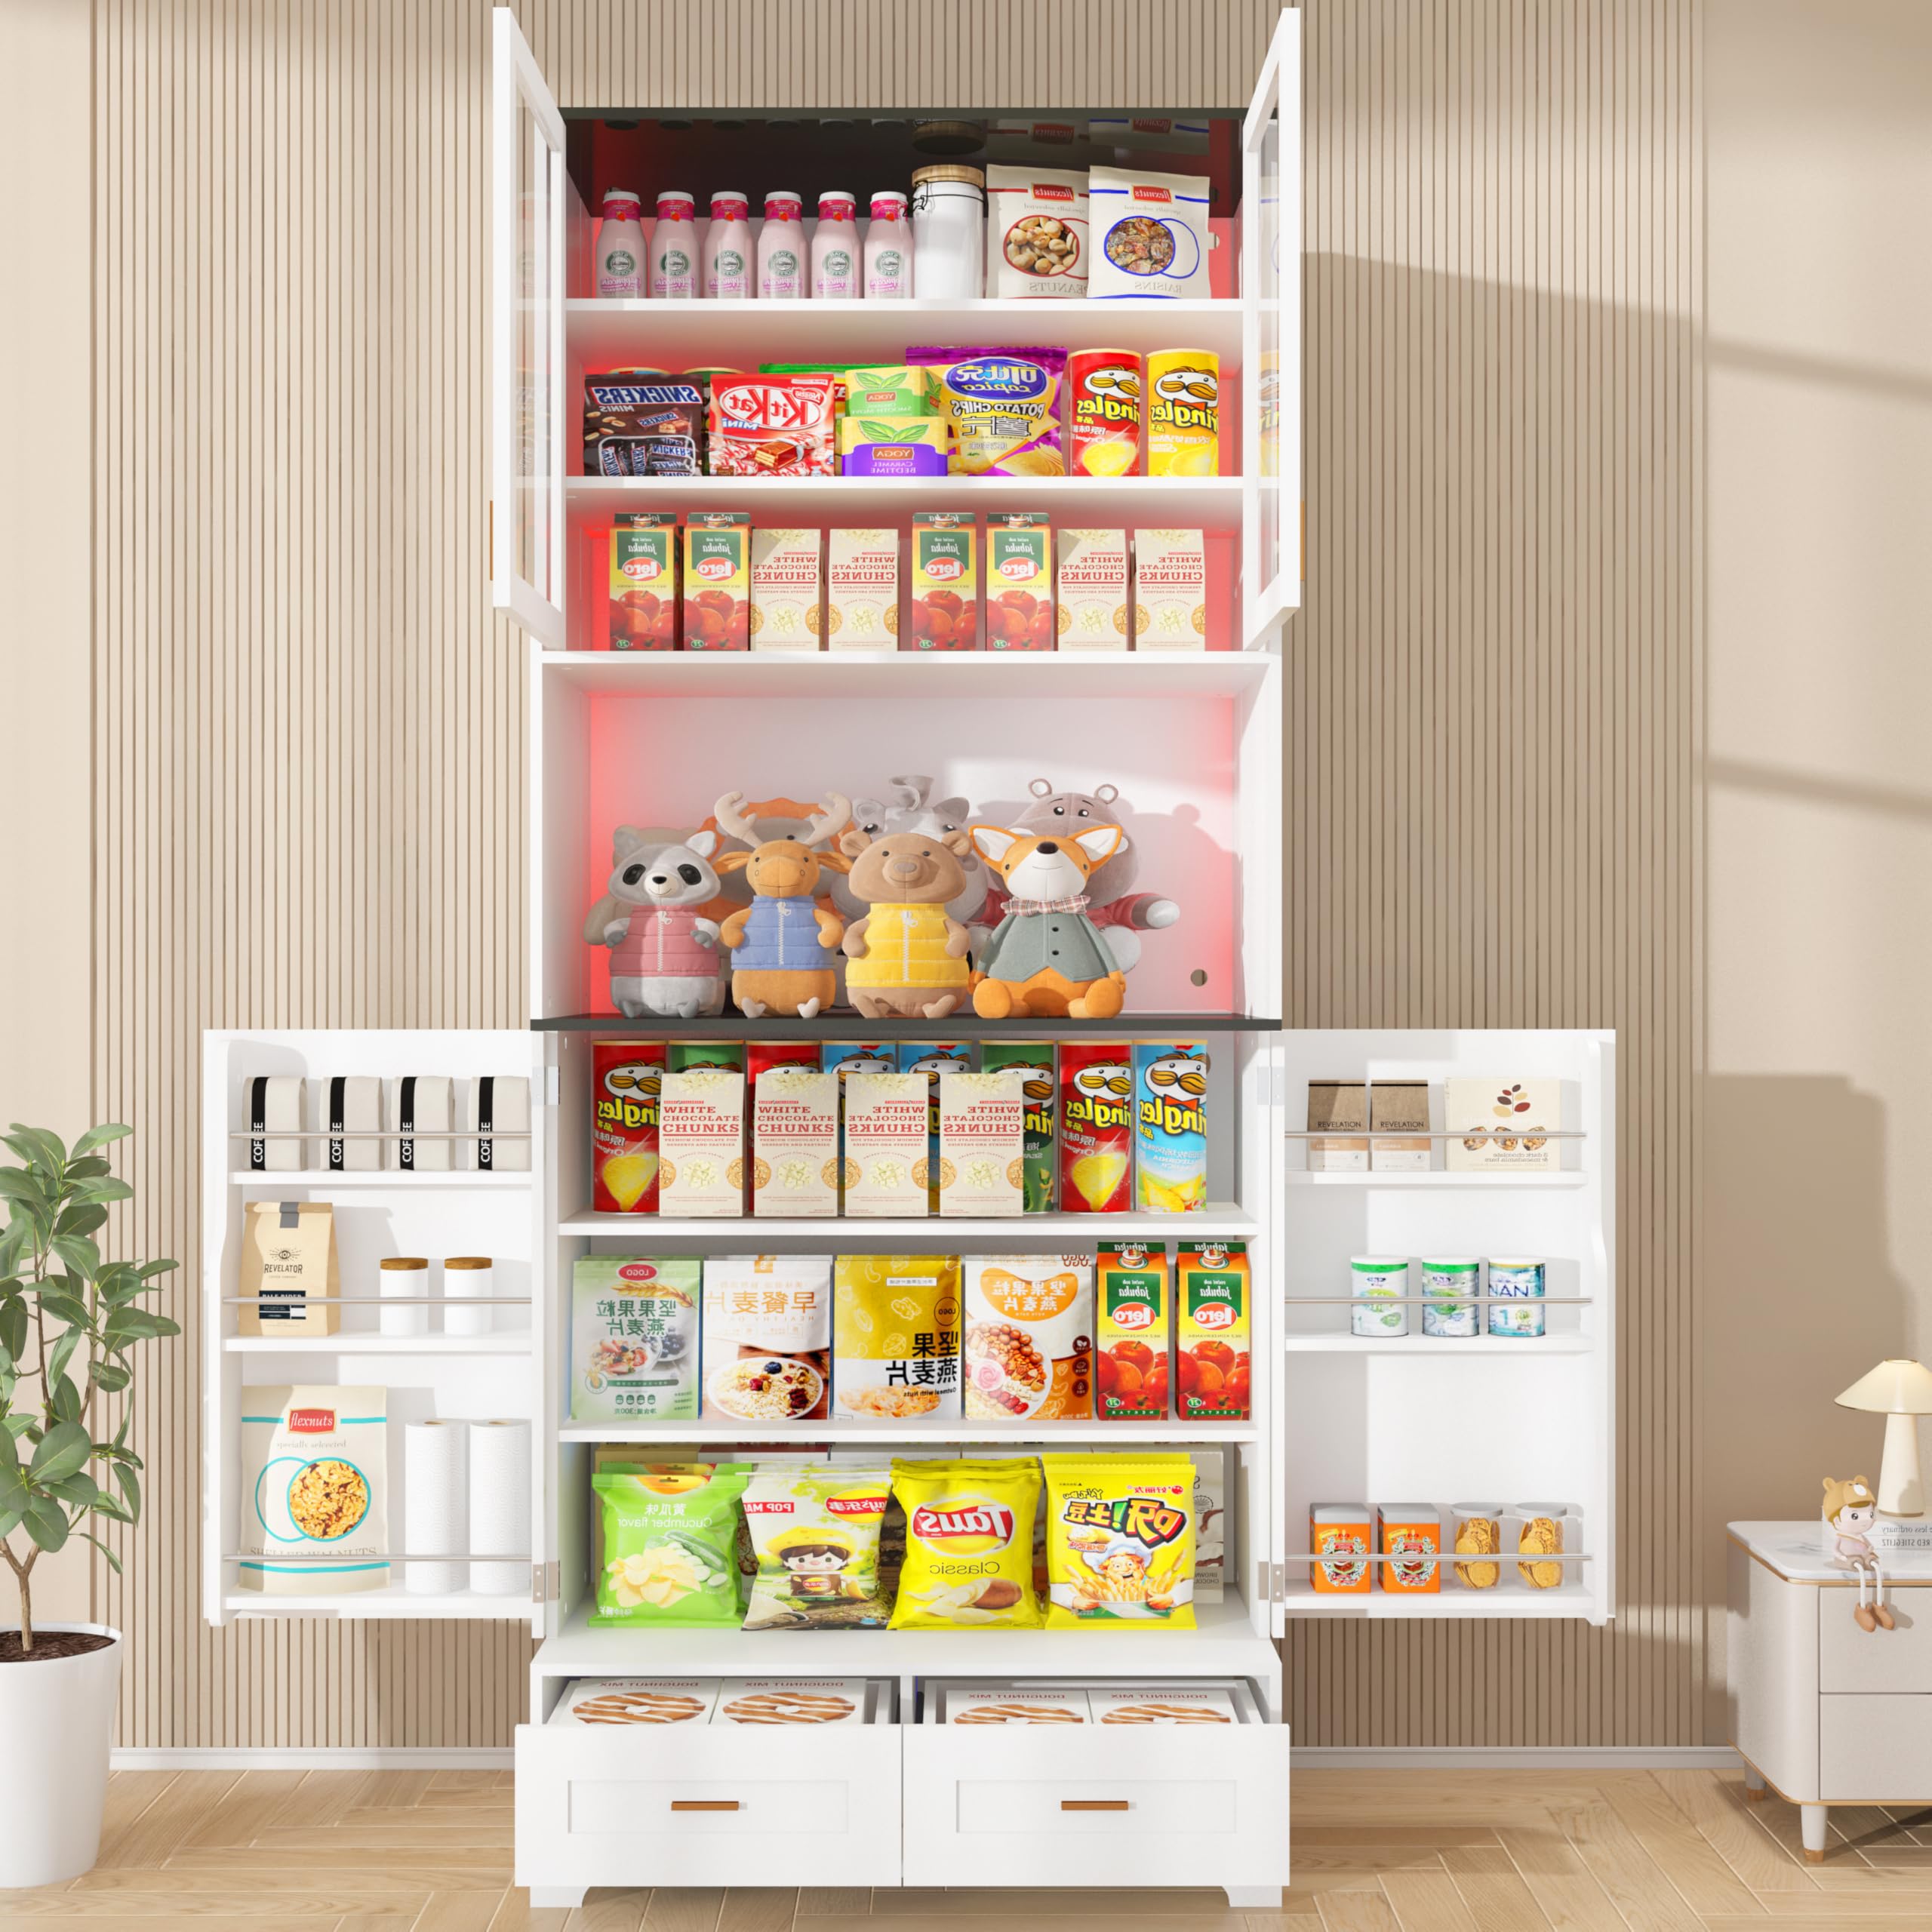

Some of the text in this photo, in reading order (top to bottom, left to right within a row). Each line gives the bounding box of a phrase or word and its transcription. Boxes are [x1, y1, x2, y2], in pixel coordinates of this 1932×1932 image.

[663, 1123, 740, 1133] CHUNKS
[758, 1123, 834, 1133] CHUNKS
[264, 1263, 303, 1274] REVELATOR
[290, 1413, 334, 1429] flexnuts
